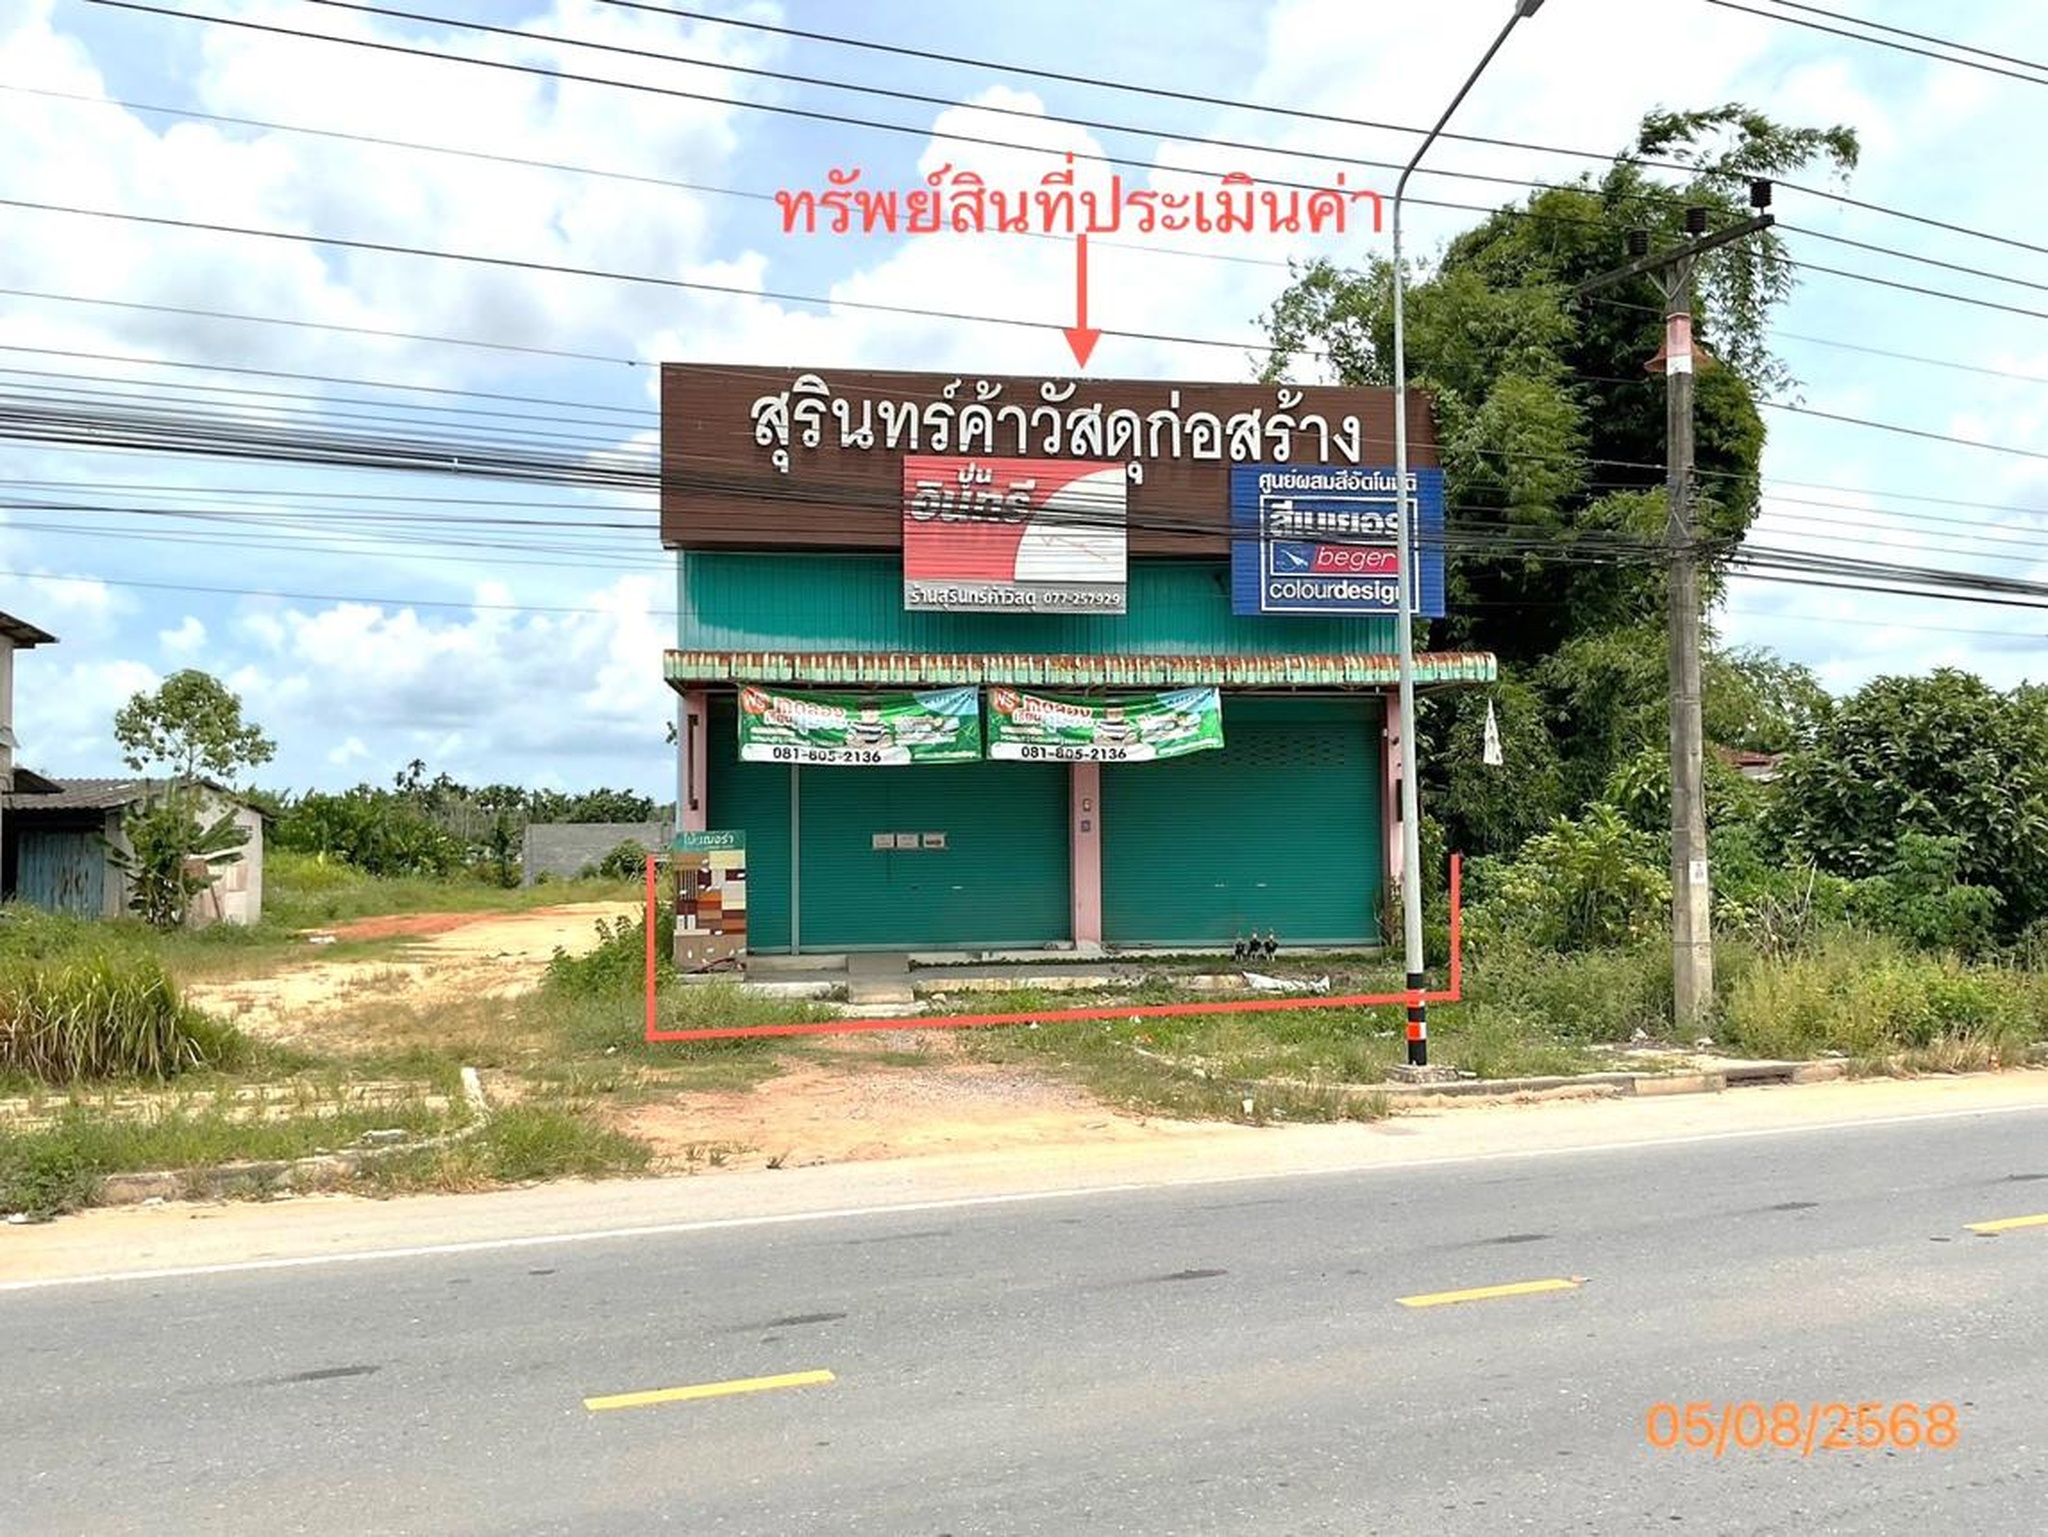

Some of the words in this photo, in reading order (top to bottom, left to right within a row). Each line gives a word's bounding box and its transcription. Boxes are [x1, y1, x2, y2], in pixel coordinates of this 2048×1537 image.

[750, 374, 1361, 485] สุรินทร์ค้าวัสดุก่อสร้าง
[1258, 469, 1418, 494] ศูนย์ผสมสีอัตโนติ
[1316, 546, 1397, 572] beger
[1043, 593, 1121, 605] 077-257929
[1269, 579, 1400, 605] colourdesig
[1021, 746, 1127, 760] 081-805-2136
